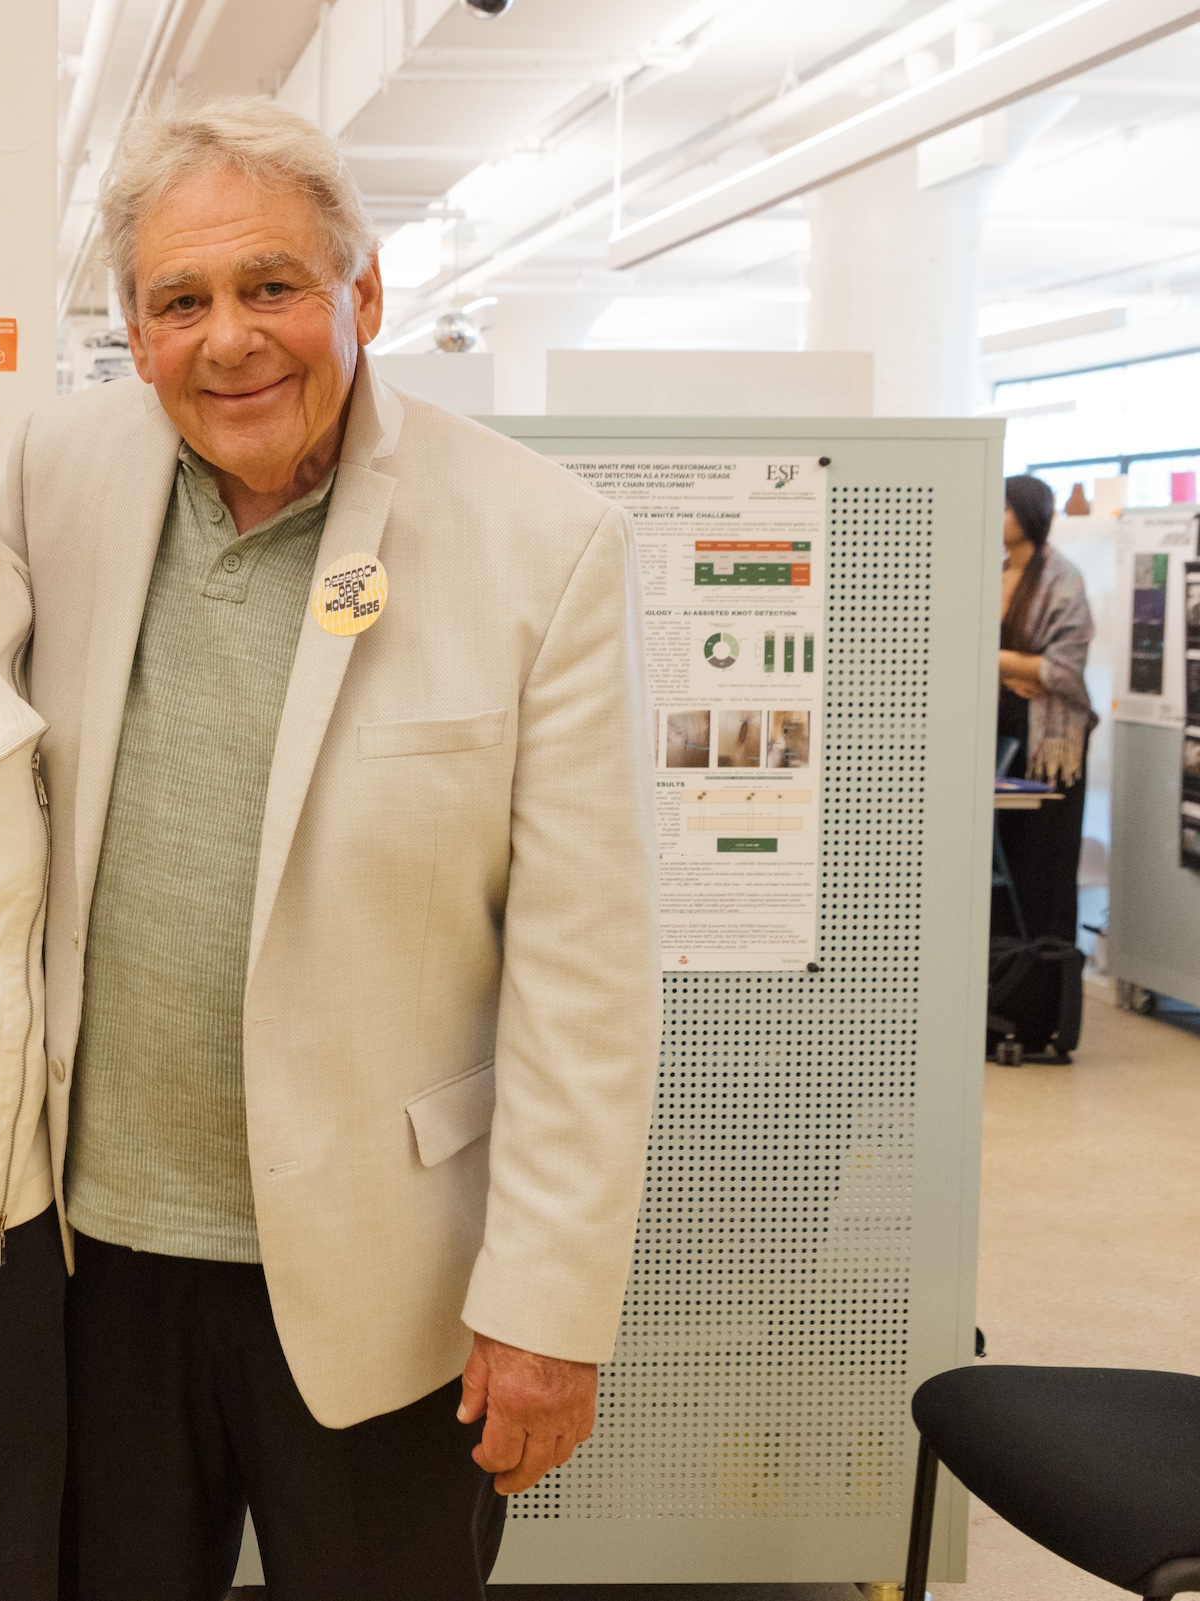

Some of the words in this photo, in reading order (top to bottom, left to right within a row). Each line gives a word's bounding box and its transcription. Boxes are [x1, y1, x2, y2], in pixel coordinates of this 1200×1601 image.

[766, 464, 800, 482] ESF
[324, 562, 377, 589] RESEARCH
[339, 579, 365, 597] OPEN
[326, 594, 359, 614] HOUSE
[354, 600, 379, 618] 2026
